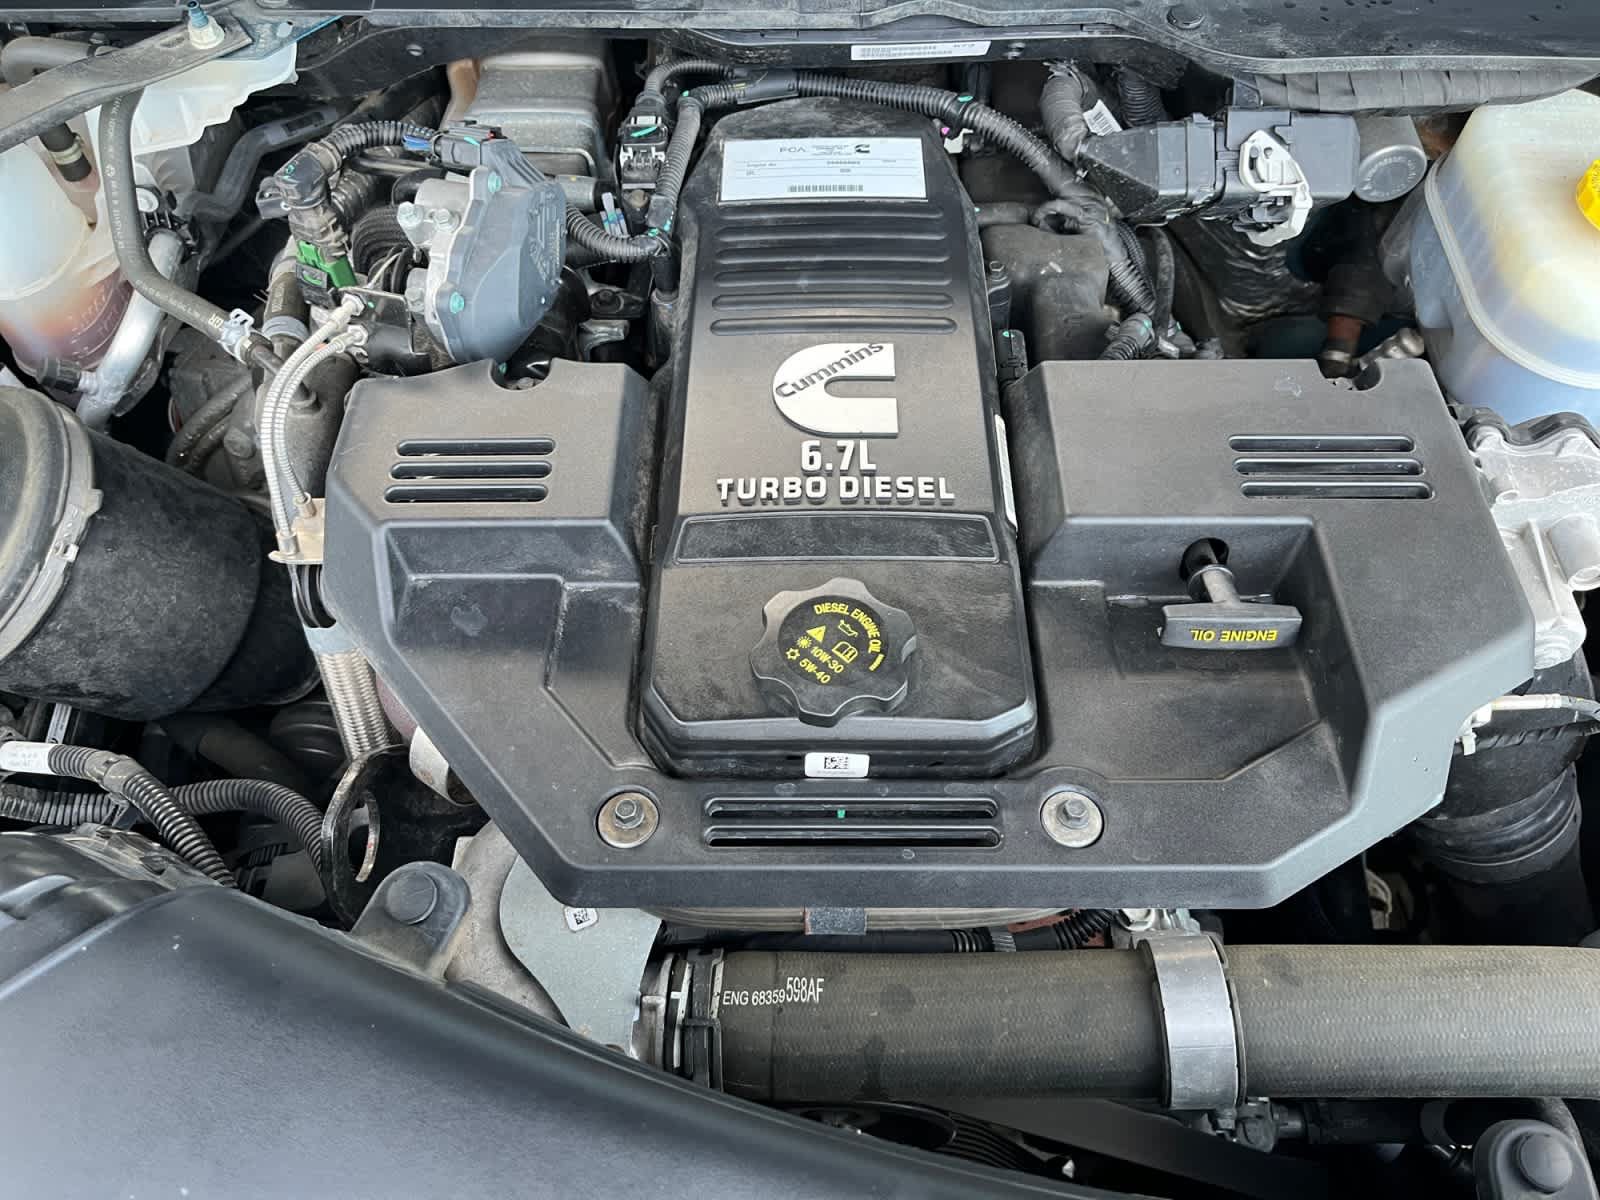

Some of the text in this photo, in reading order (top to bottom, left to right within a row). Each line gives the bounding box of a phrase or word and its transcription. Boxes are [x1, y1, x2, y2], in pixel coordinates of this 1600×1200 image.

[775, 342, 884, 398] Cummins
[801, 440, 877, 473] 6.7L
[717, 476, 956, 502] TURBO DIESEL
[814, 603, 881, 654] DIESEL ENGINE OIL
[1190, 629, 1278, 641] ENGINE OIL
[799, 659, 830, 683] 5W-40
[811, 646, 844, 673] 10W-30
[722, 990, 749, 1006] ENG
